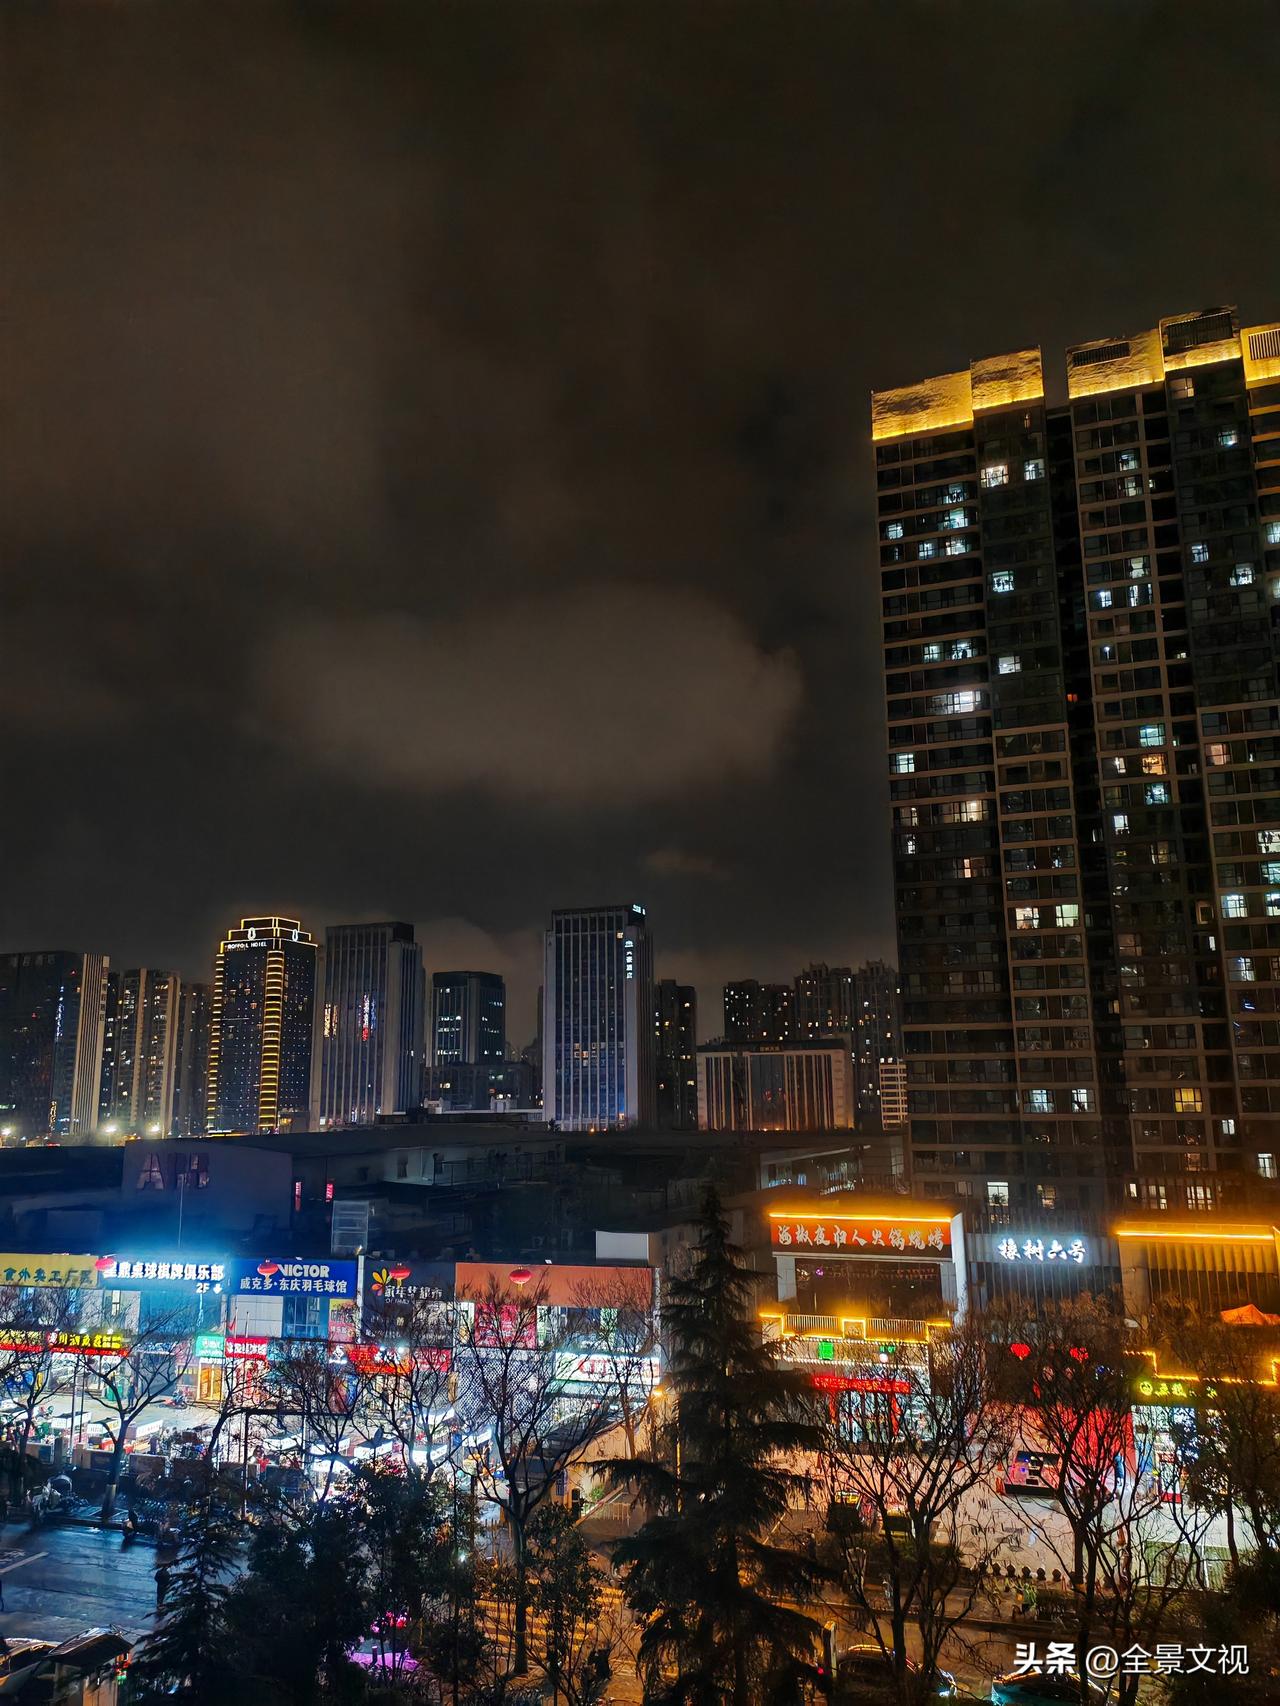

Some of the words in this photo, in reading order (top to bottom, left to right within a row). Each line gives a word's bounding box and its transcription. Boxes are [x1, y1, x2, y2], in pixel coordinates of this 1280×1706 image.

[997, 1238, 1086, 1264] 橡树六号
[278, 1264, 330, 1278] VICTOR
[196, 1283, 210, 1294] 2F
